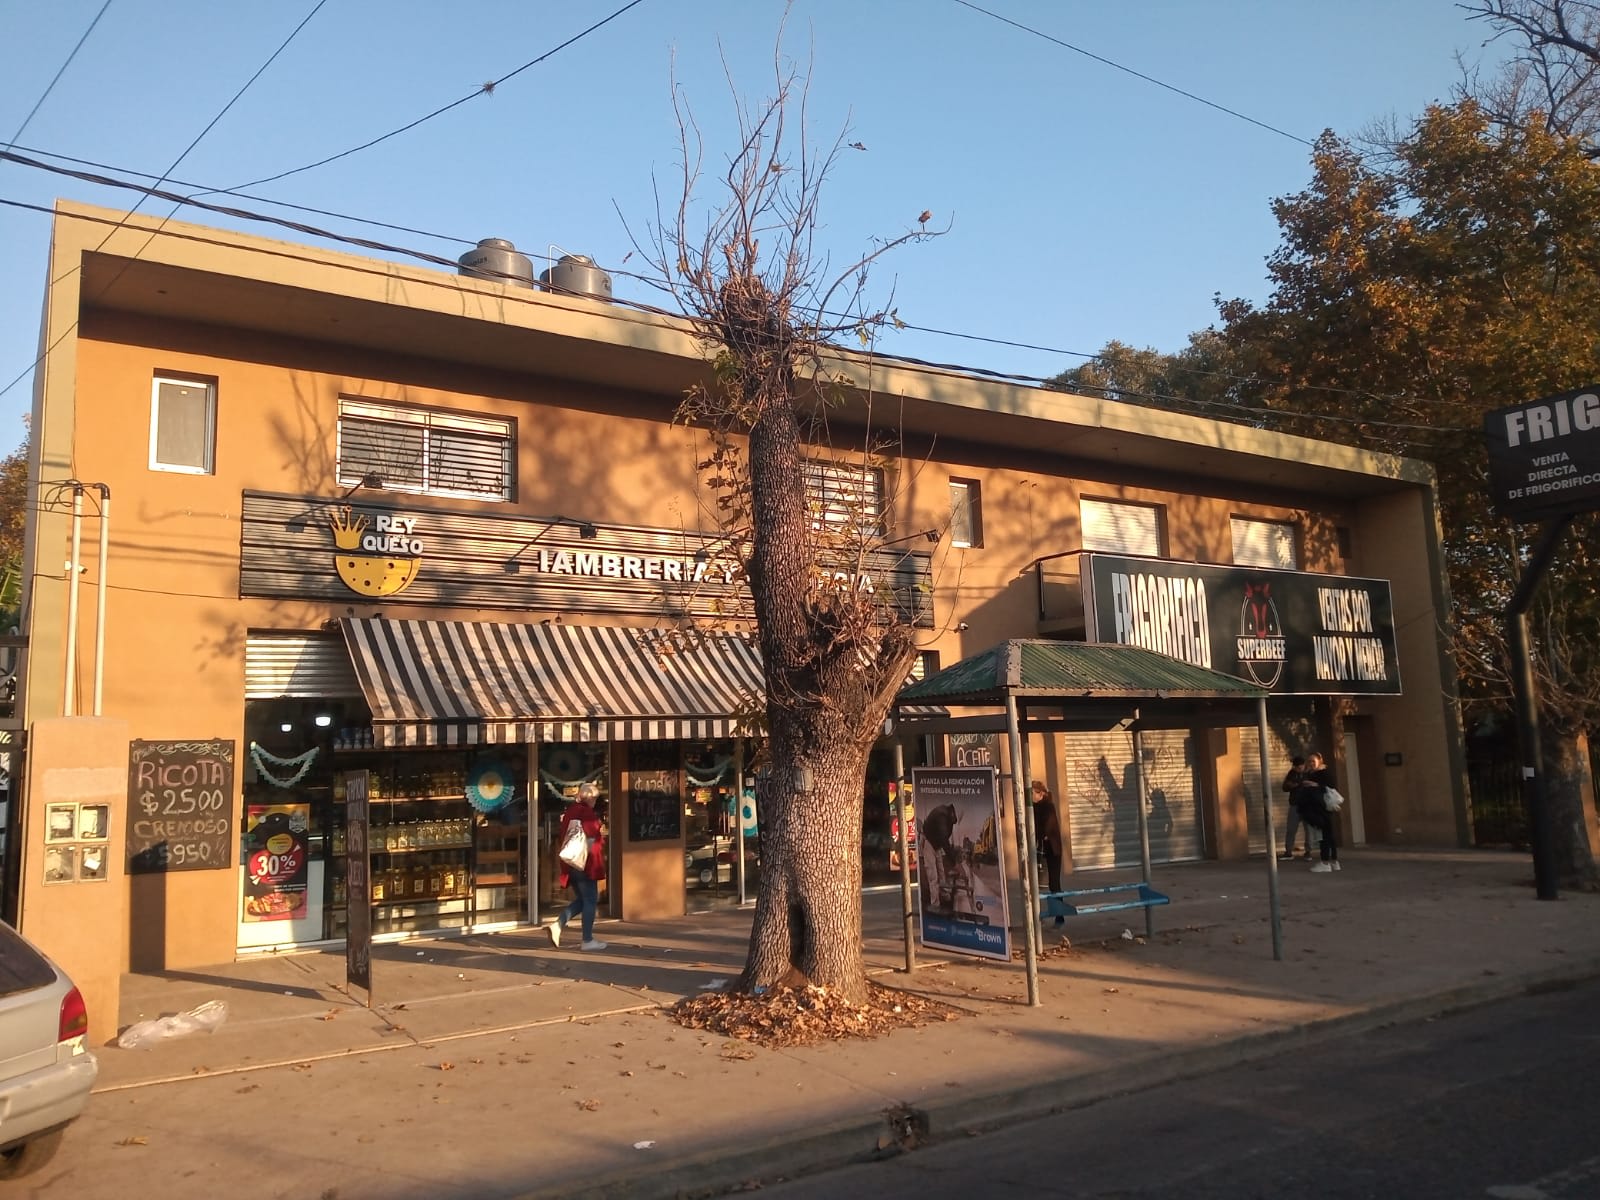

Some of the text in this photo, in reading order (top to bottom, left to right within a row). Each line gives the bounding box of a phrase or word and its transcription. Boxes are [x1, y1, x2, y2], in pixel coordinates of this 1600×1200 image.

[1505, 394, 1600, 447] FRIG
[1532, 452, 1570, 467] VENTA
[1528, 464, 1578, 482] DIRECTA
[1508, 473, 1600, 499] DE FRIGORIFICO
[376, 515, 417, 534] REY
[362, 535, 424, 554] QUESO
[1318, 587, 1374, 632] VENTAS POR
[1111, 572, 1212, 669] FRIGORIFICO
[1237, 638, 1286, 660] SUPERBEEF
[1313, 636, 1387, 681] MAYOR Y MENOR
[919, 777, 940, 785] AVANZA
[133, 818, 228, 838] CREMOSO
